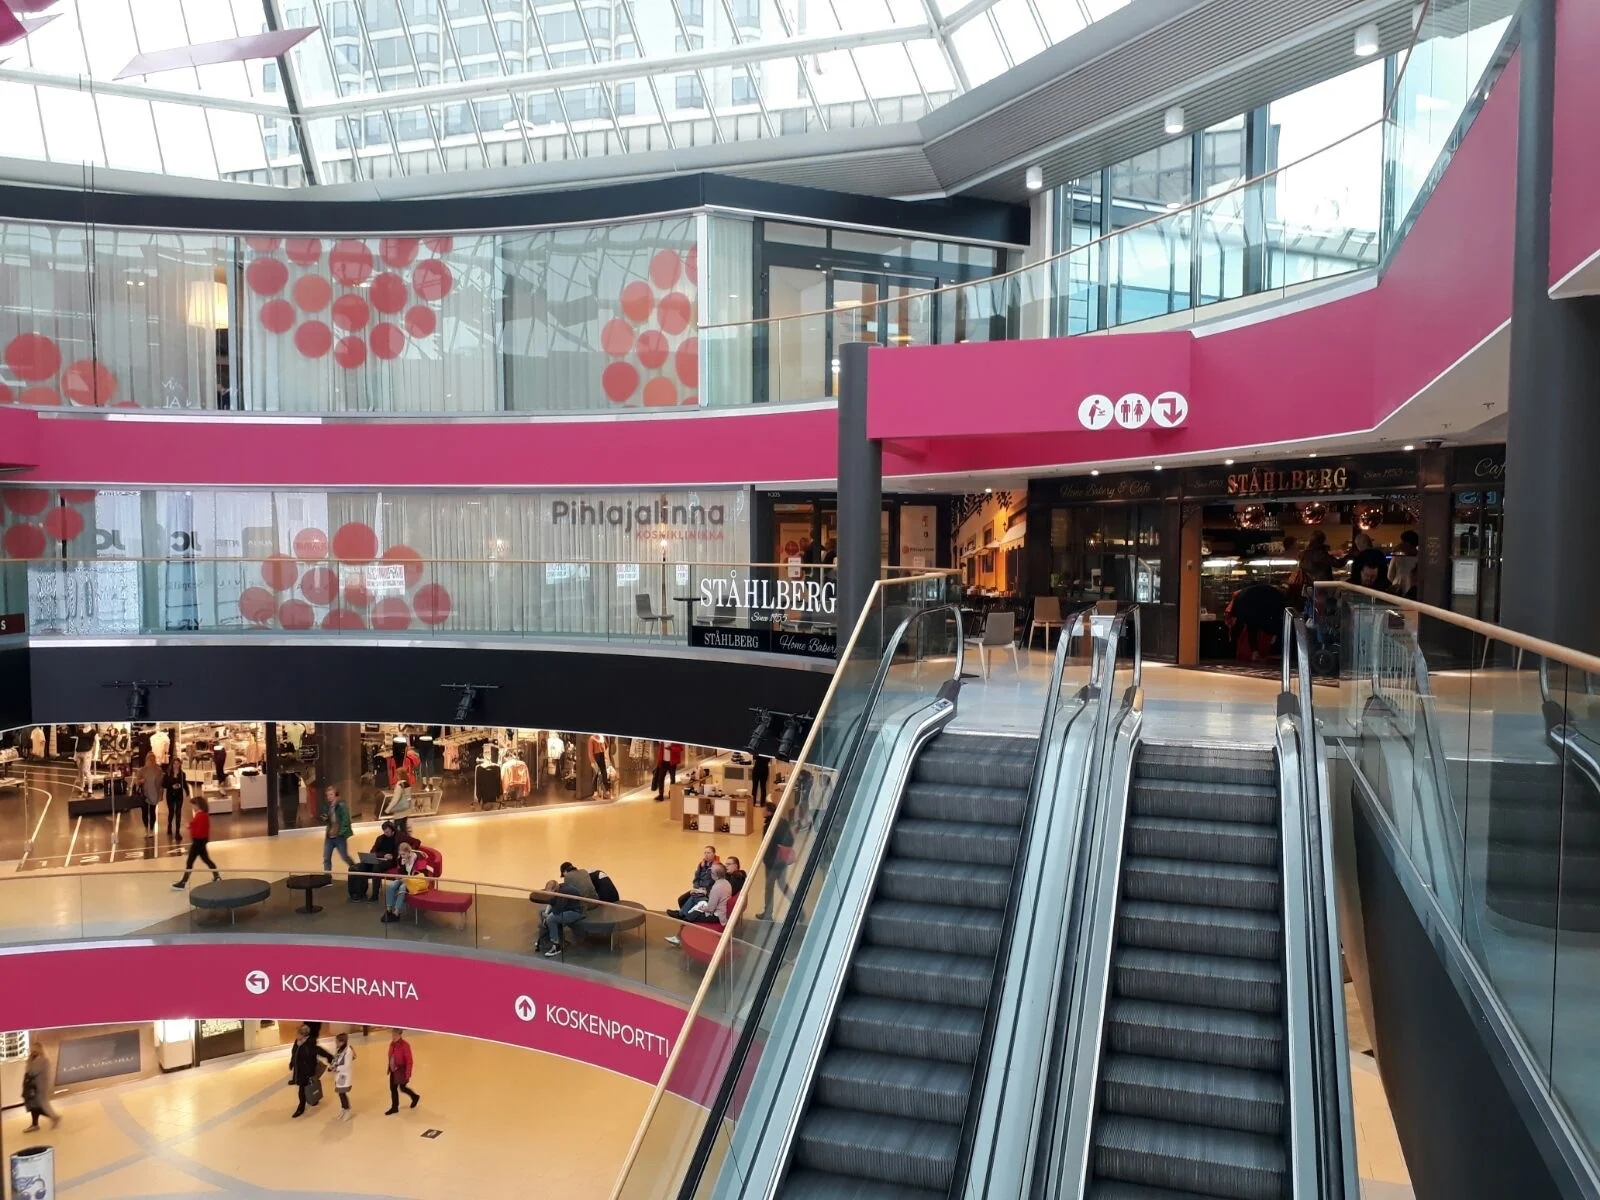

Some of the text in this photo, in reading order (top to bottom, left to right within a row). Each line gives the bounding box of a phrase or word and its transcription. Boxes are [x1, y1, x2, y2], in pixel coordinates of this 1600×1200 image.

[1227, 467, 1348, 494] STÅHLBERG
[1474, 457, 1507, 478] Caf
[551, 500, 725, 532] Pihlajalinna
[700, 569, 837, 614] STÅHLBERG
[704, 630, 759, 648] STÅHLBERG
[779, 634, 806, 650] Home
[281, 974, 419, 1001] KOSKENRANTA
[546, 1004, 670, 1058] KOSKENPORTTI
